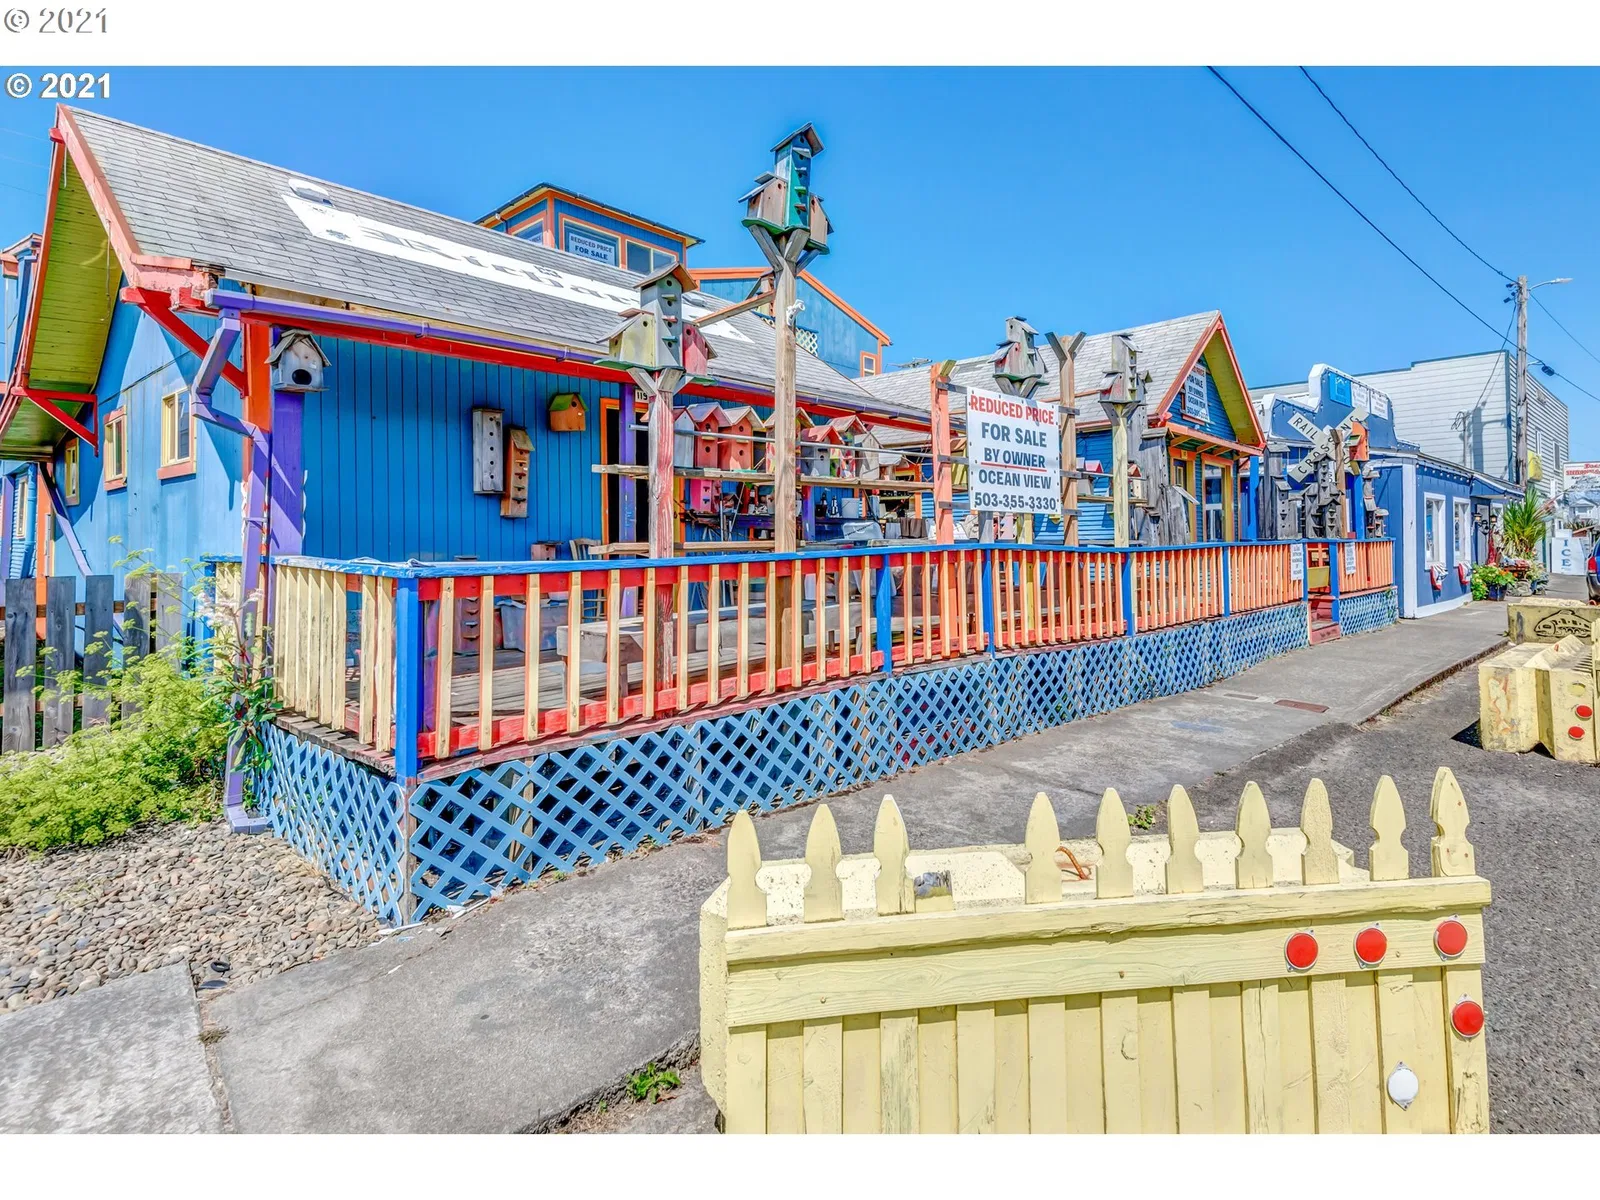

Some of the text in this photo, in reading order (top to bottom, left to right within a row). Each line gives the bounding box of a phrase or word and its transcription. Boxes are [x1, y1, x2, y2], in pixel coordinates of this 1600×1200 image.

[571, 235, 613, 253] REDUCED PRICE
[575, 245, 608, 260] FOR SALE
[359, 225, 639, 305] Richar
[970, 395, 1054, 425] REDUCED PRICE
[981, 422, 1047, 448] FOR SALE
[1293, 417, 1318, 440] RAIL
[1298, 415, 1363, 474] CROSSNG
[984, 447, 1046, 468] BY OWNER
[978, 469, 1052, 489] OCEAN VIEW
[974, 491, 1057, 511] 503-355-3330
[1561, 539, 1572, 567] ICE
